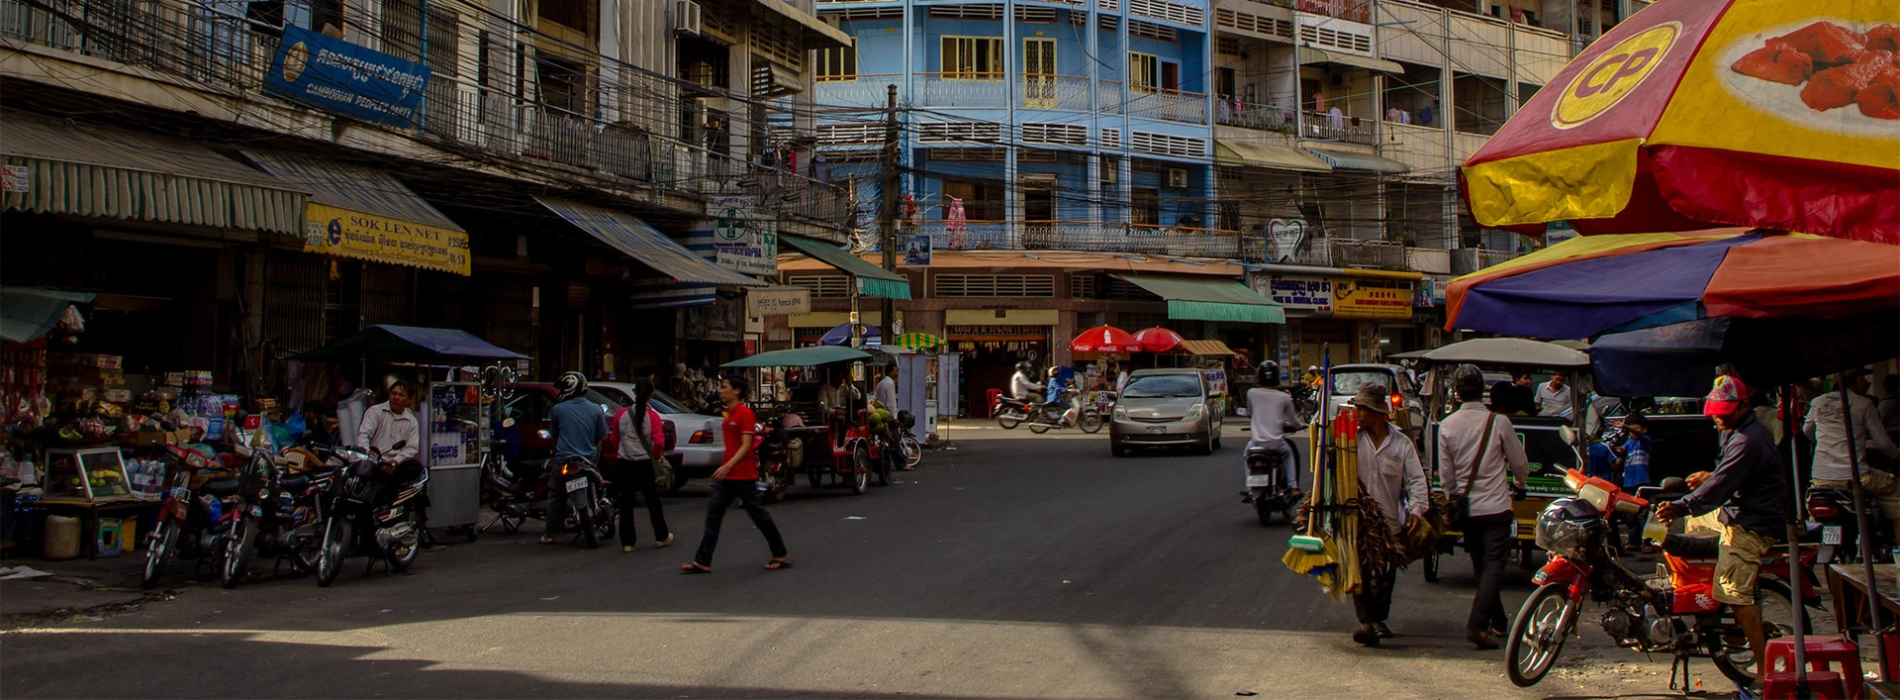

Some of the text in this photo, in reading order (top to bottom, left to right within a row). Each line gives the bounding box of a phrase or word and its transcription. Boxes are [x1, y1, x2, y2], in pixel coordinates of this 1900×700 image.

[1575, 47, 1659, 98] CP
[306, 83, 354, 104] CAMBODIAN
[390, 105, 413, 119] PARTY
[350, 216, 441, 241] SOK LEN NET
[1312, 297, 1329, 305] CLINIC
